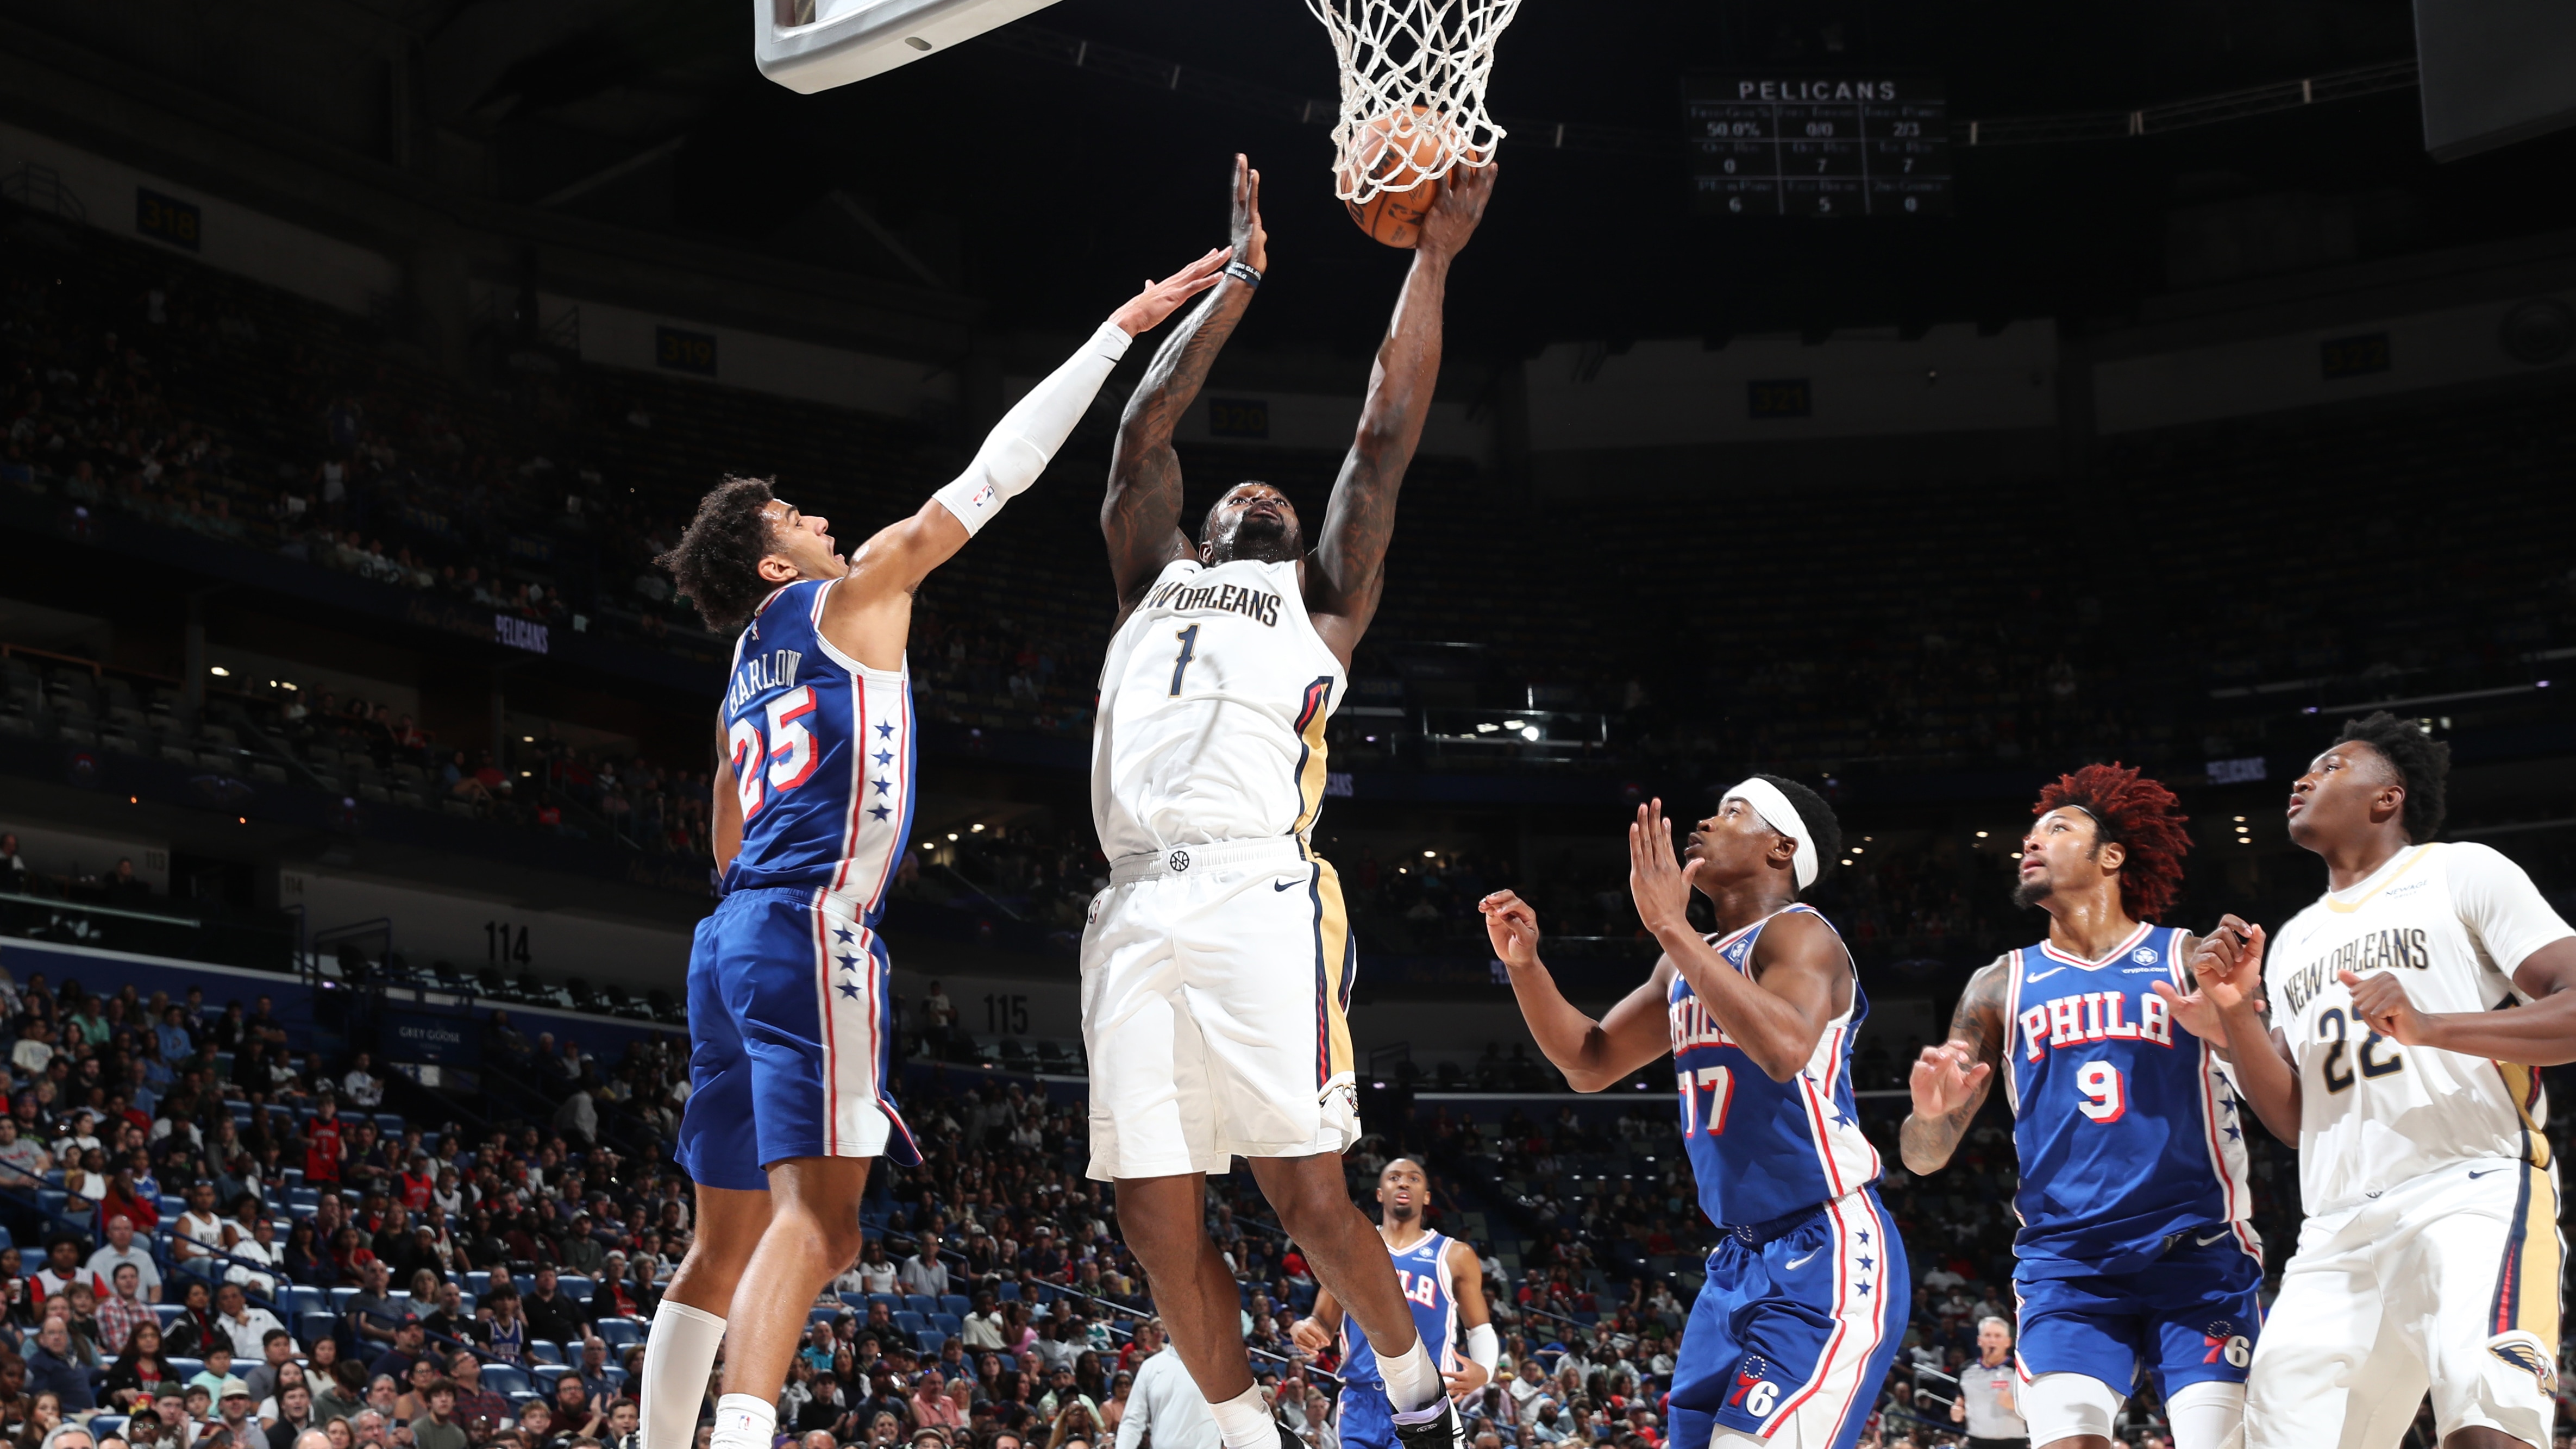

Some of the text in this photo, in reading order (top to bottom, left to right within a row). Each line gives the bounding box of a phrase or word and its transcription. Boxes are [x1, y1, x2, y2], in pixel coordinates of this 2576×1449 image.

[1739, 80, 1896, 101] PELICANS
[1805, 121, 1834, 137] 0/0
[1893, 121, 1921, 137] 2/3
[1723, 158, 1737, 174] 0
[1816, 158, 1828, 174] 7
[1902, 158, 1913, 174] 7
[142, 199, 197, 241] 318
[1728, 196, 1743, 213] 6
[1818, 196, 1832, 213] 5
[662, 335, 712, 366] 319
[2326, 341, 2387, 372] 322
[1755, 386, 1805, 412] 321
[1212, 405, 1265, 432] 320
[1135, 581, 1281, 628] EW ORLEANS
[495, 613, 549, 655] PELICANS
[1168, 623, 1201, 698] 1
[729, 685, 818, 823] 25
[2385, 878, 2429, 898] NEWAGE
[484, 920, 531, 965] 114
[2284, 928, 2430, 1022] NEW ORLEANS
[983, 993, 1028, 1035] 115
[2019, 991, 2174, 1064] PHILA
[2318, 1001, 2404, 1096] 22
[1677, 1065, 1735, 1138] 77
[2076, 1060, 2126, 1124] 9
[2203, 1334, 2250, 1368] 76
[1729, 1371, 1780, 1417] 76
